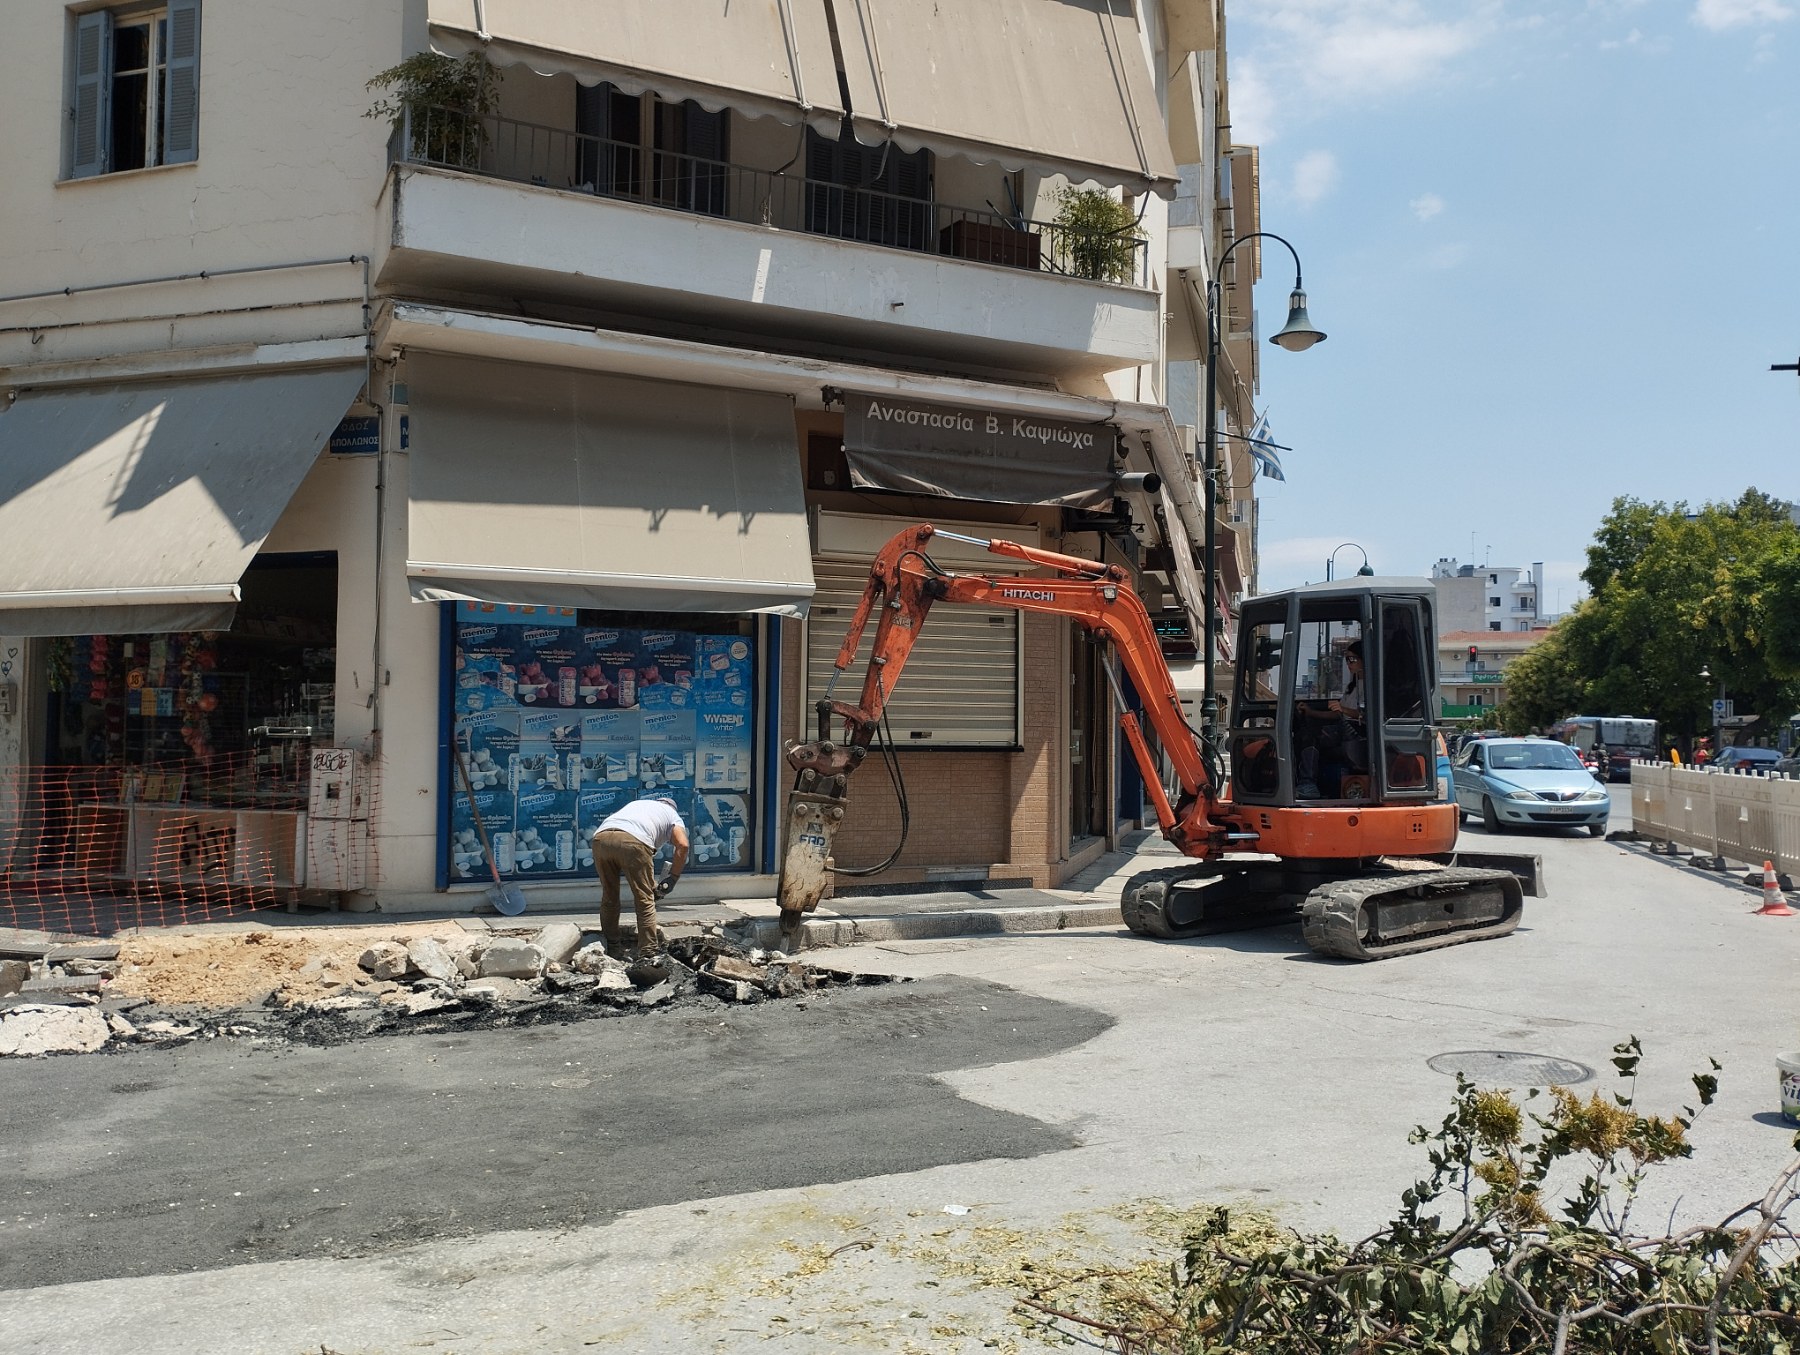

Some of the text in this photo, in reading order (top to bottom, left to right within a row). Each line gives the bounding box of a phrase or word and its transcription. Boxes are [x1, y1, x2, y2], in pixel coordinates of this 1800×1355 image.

[341, 420, 369, 432] ΟΔΟΣ
[867, 401, 974, 431] Αναστασία
[1012, 418, 1094, 450] Καψιώχα
[331, 436, 379, 447] ΑΠΟΛΛΩΝΟΣ
[1003, 588, 1054, 602] HITACHI
[461, 626, 497, 638] mentos
[524, 629, 560, 641] mentos
[585, 632, 618, 643] mentos
[643, 634, 675, 646] mentos
[461, 711, 497, 723] mentos
[526, 713, 559, 724] mentos
[586, 713, 619, 724] mentos
[645, 714, 677, 725] mentos
[521, 793, 555, 806] mentos
[582, 792, 616, 805] mentos
